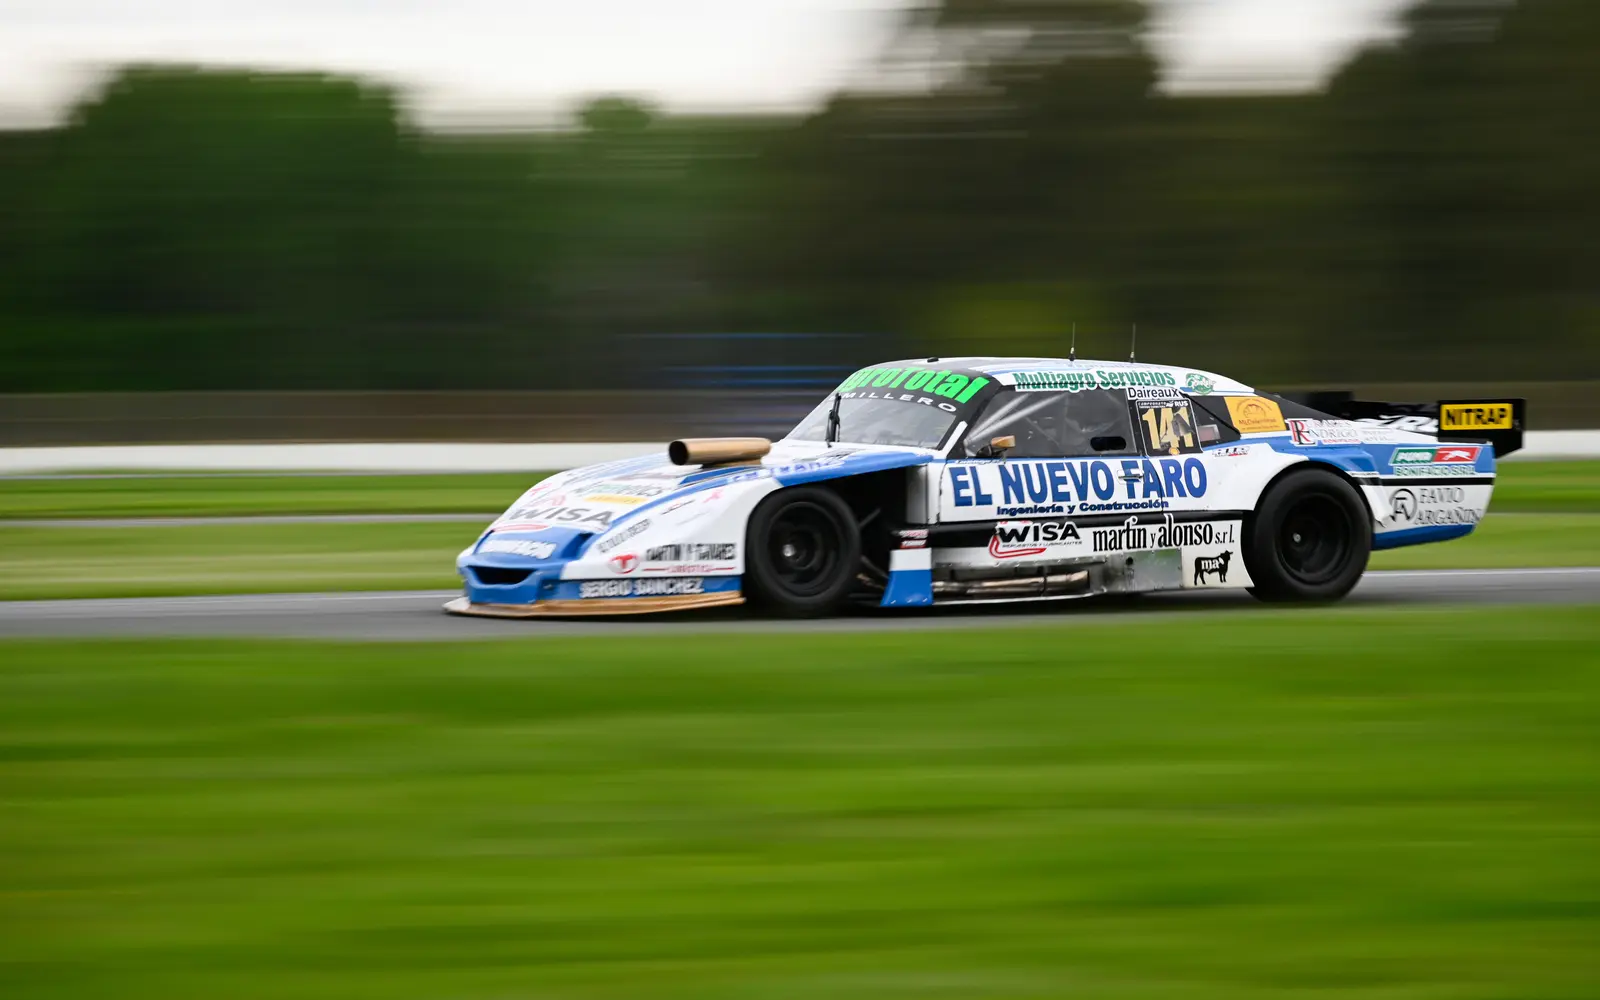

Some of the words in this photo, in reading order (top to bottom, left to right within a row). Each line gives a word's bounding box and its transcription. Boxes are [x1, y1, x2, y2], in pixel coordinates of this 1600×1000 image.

[1012, 371, 1096, 392] Multiagro
[1097, 370, 1176, 388] Servicios
[1128, 386, 1179, 398] Daireaux
[1445, 408, 1506, 425] NITRAP
[1142, 407, 1194, 449] 141
[949, 465, 992, 507] EL
[997, 460, 1114, 505] NUEVO
[1121, 457, 1208, 499] FARO
[1419, 487, 1465, 503] FAVIO
[509, 506, 615, 526] WISA
[1067, 503, 1076, 514] y
[1079, 499, 1169, 512] Construcción
[999, 523, 1081, 543] WISA
[1093, 516, 1147, 552] martin
[1150, 532, 1156, 548] y
[1158, 514, 1213, 548] alonso
[579, 580, 633, 599] SERGIO
[634, 578, 705, 596] SANCHEZ
